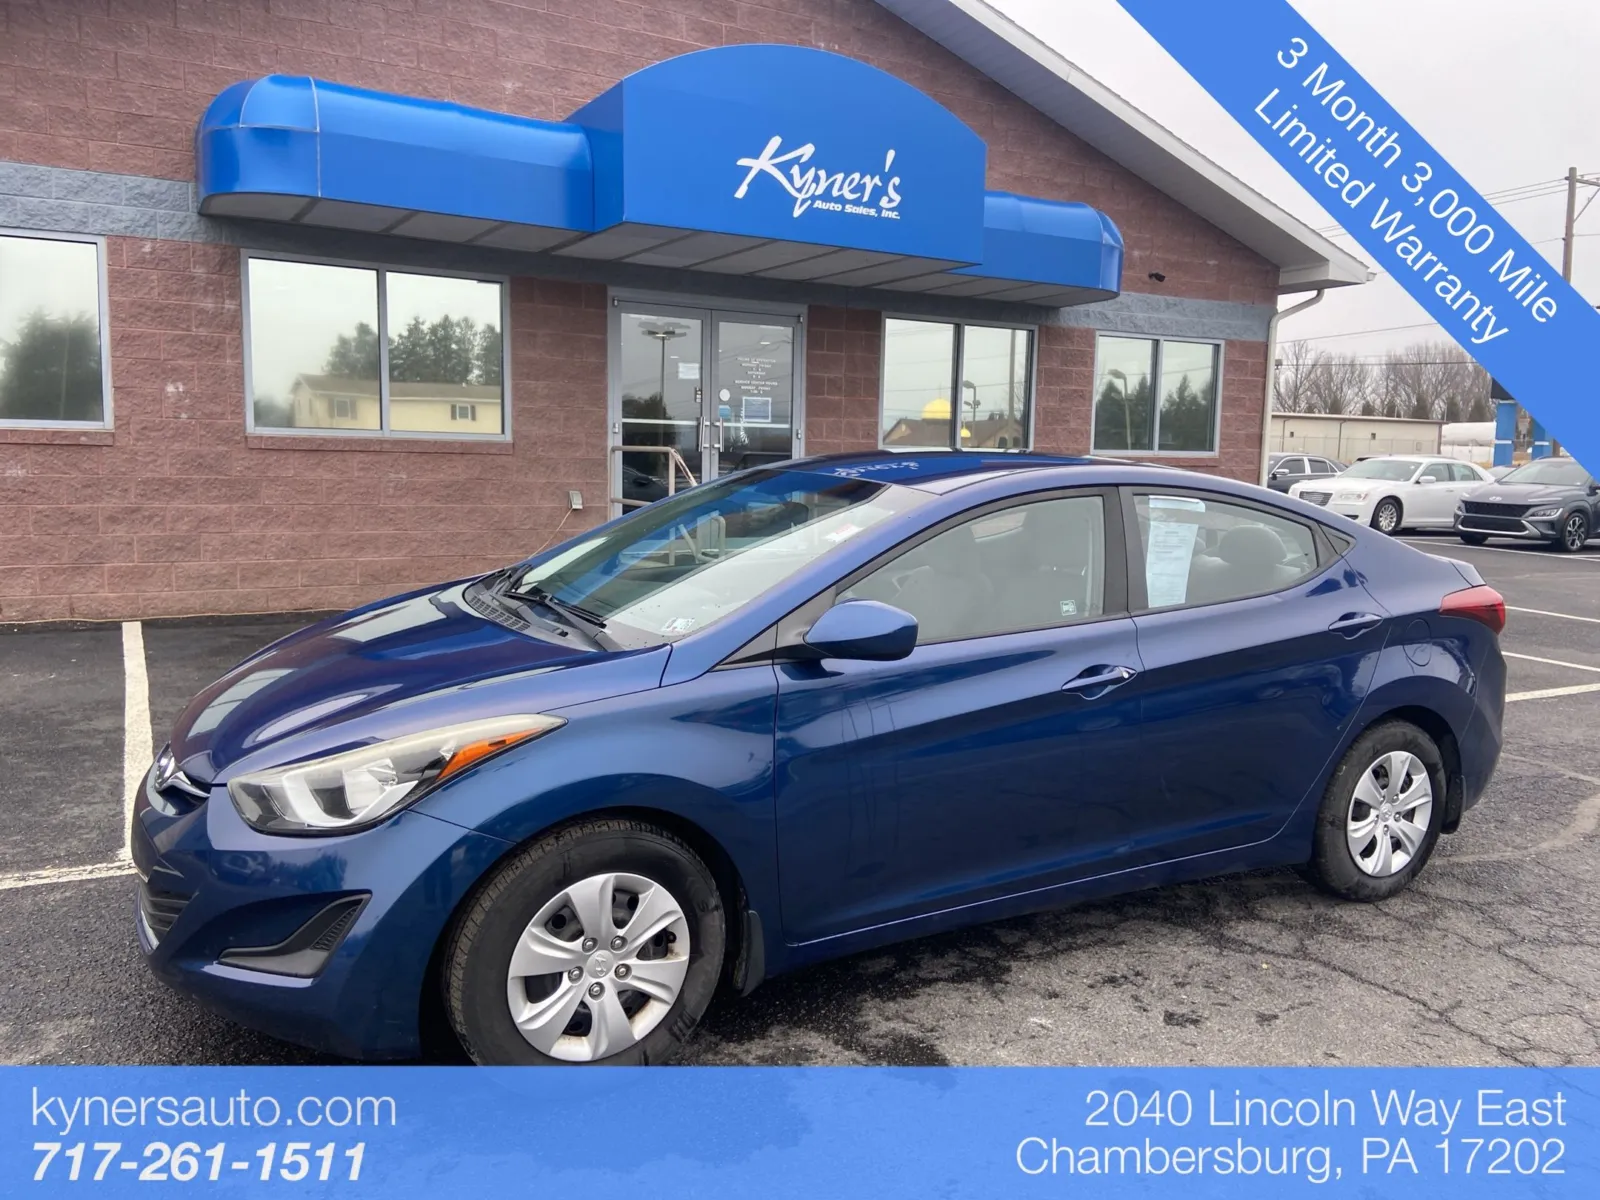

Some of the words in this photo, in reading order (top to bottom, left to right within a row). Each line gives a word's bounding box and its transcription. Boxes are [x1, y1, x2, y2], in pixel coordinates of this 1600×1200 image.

[734, 135, 901, 218] Kyner's
[813, 200, 842, 212] Auto
[844, 204, 878, 217] Sales,
[881, 209, 901, 219] Inc.
